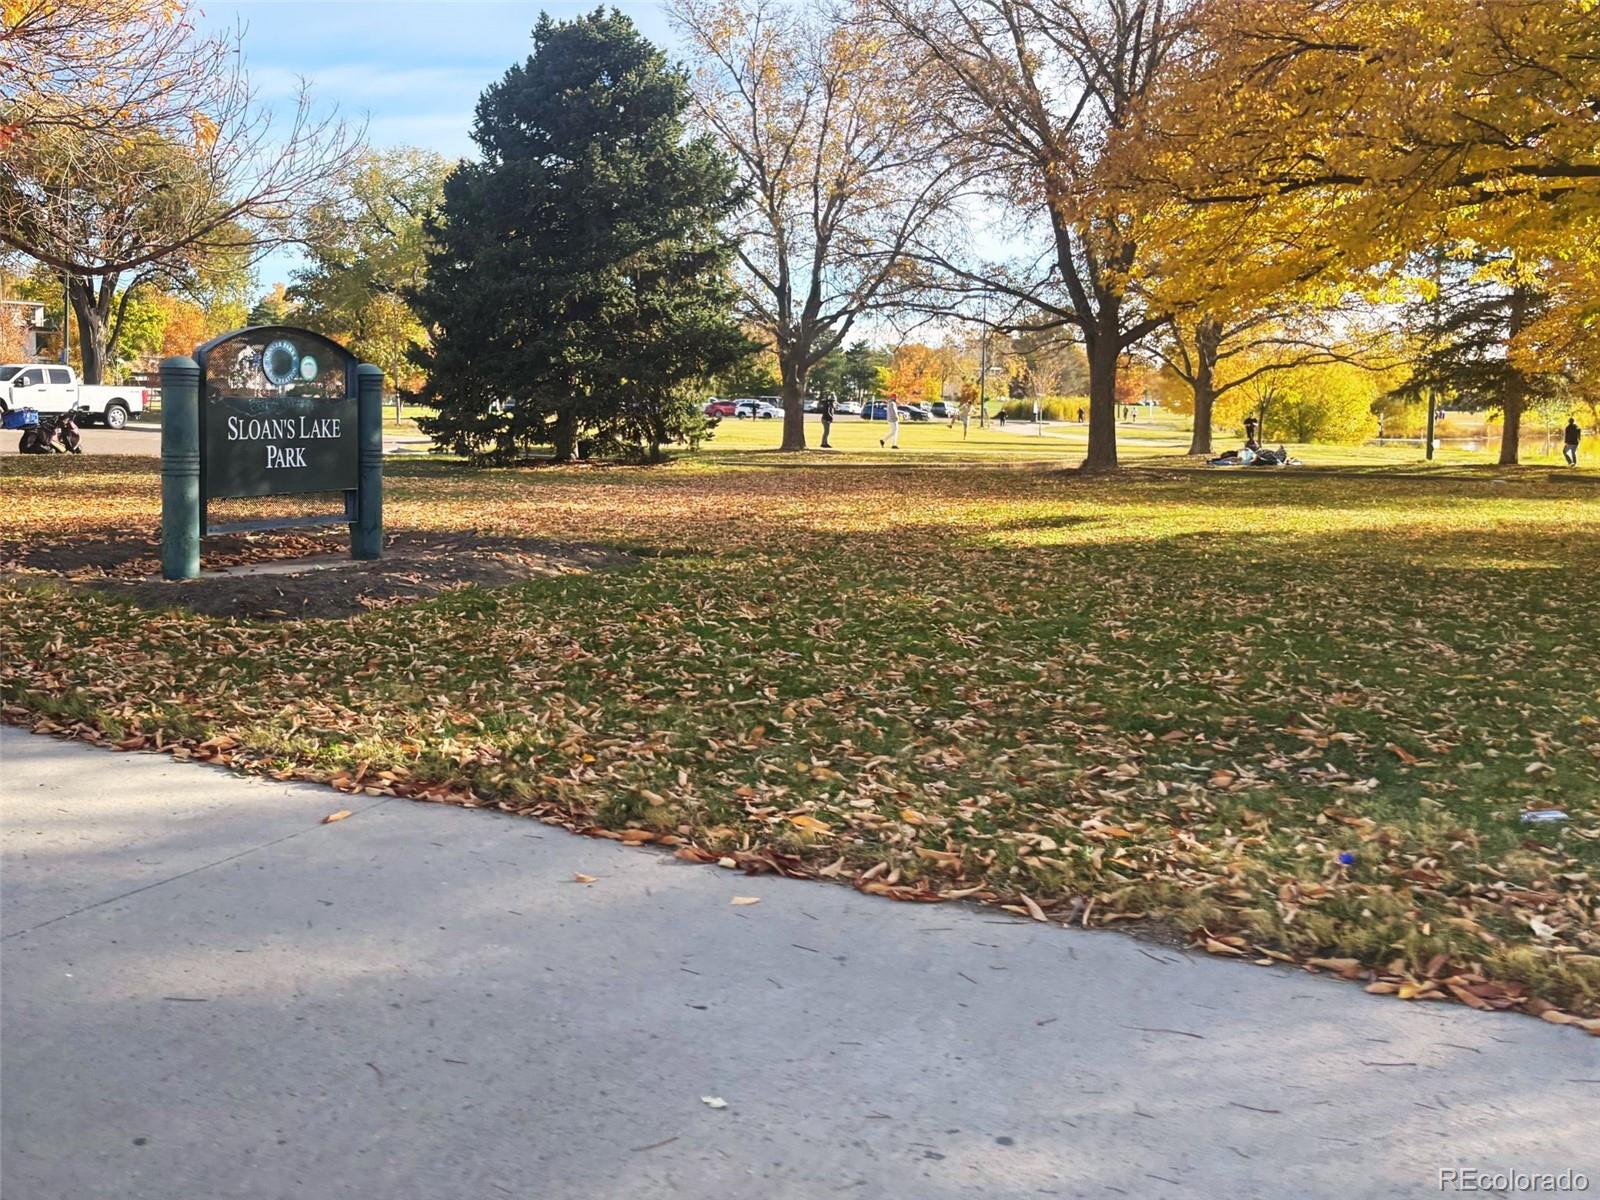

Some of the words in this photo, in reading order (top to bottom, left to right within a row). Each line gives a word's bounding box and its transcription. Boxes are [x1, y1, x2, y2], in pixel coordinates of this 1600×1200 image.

[227, 416, 296, 440] SLOAN'S
[299, 416, 342, 439] LAKE
[265, 445, 308, 469] PARK
